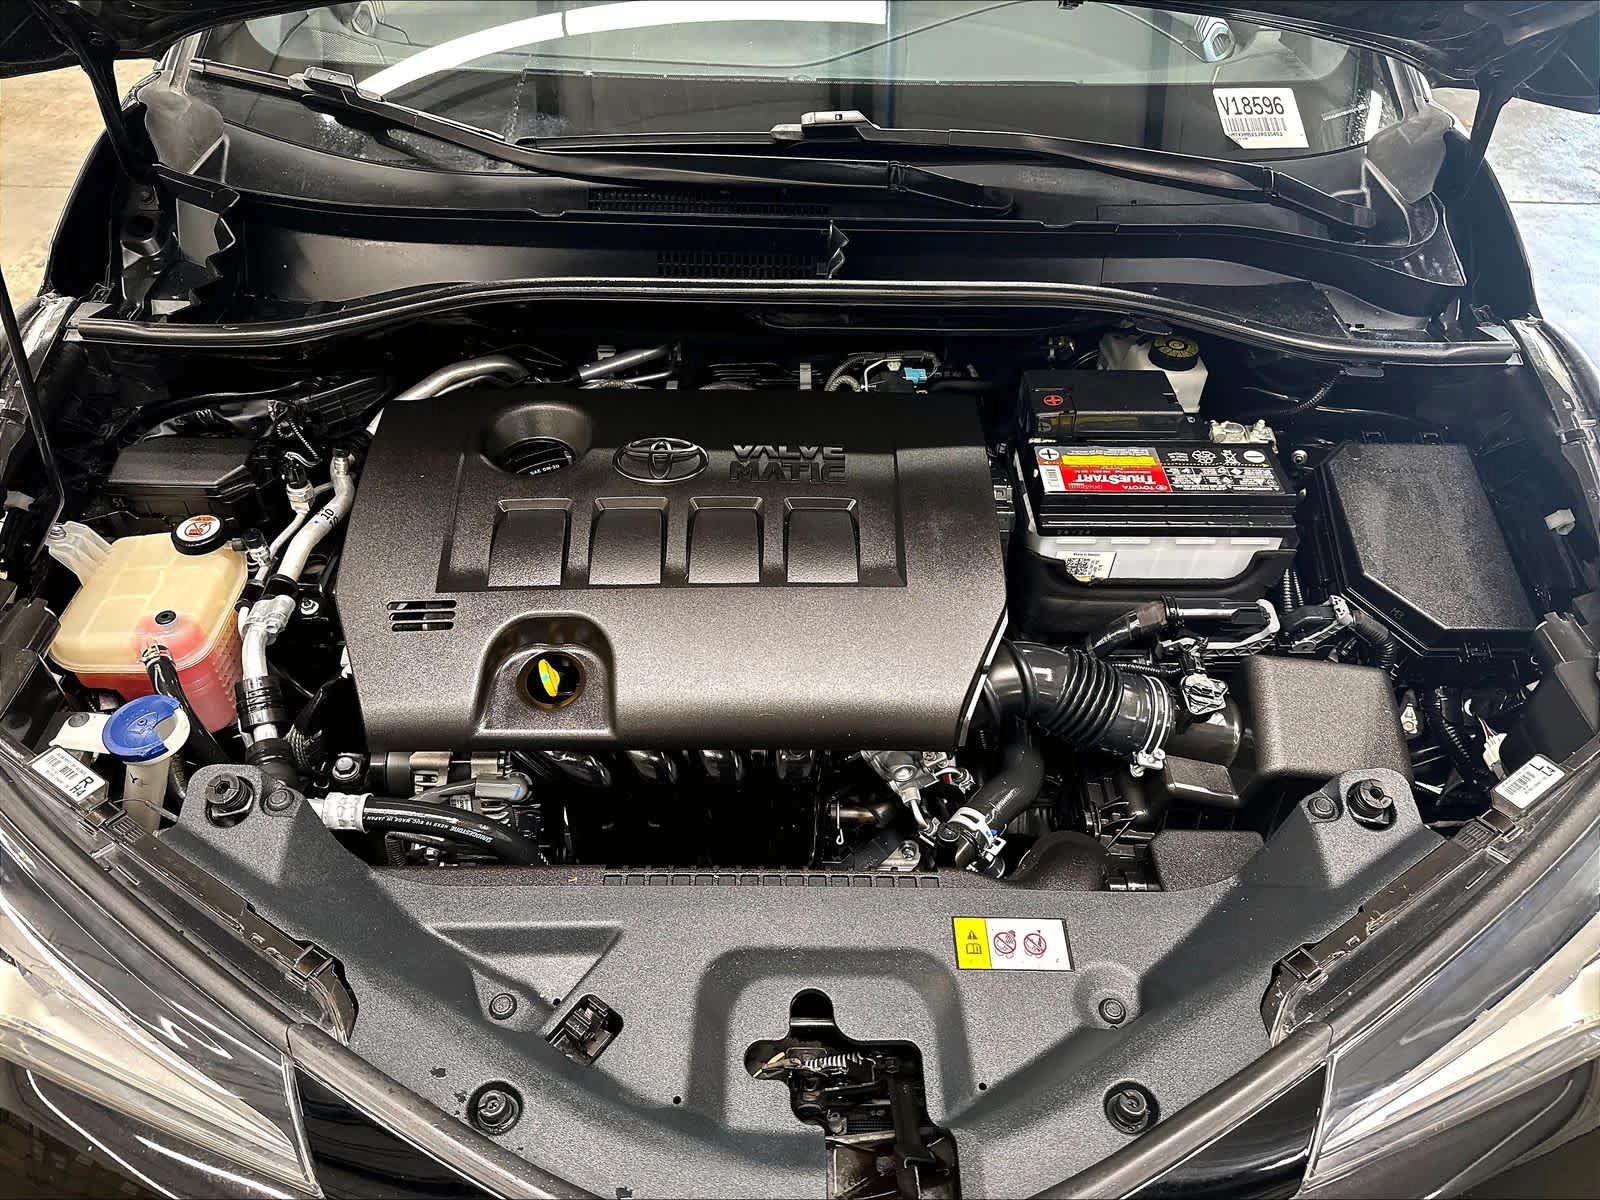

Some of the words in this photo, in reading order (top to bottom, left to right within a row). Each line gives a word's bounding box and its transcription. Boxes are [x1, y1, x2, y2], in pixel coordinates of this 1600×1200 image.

[1219, 96, 1284, 115] V18596
[733, 444, 846, 460] VALVE
[320, 508, 335, 521] 10
[1529, 763, 1544, 771] L
[81, 776, 94, 789] R
[450, 826, 493, 843] BRIDGESTONE
